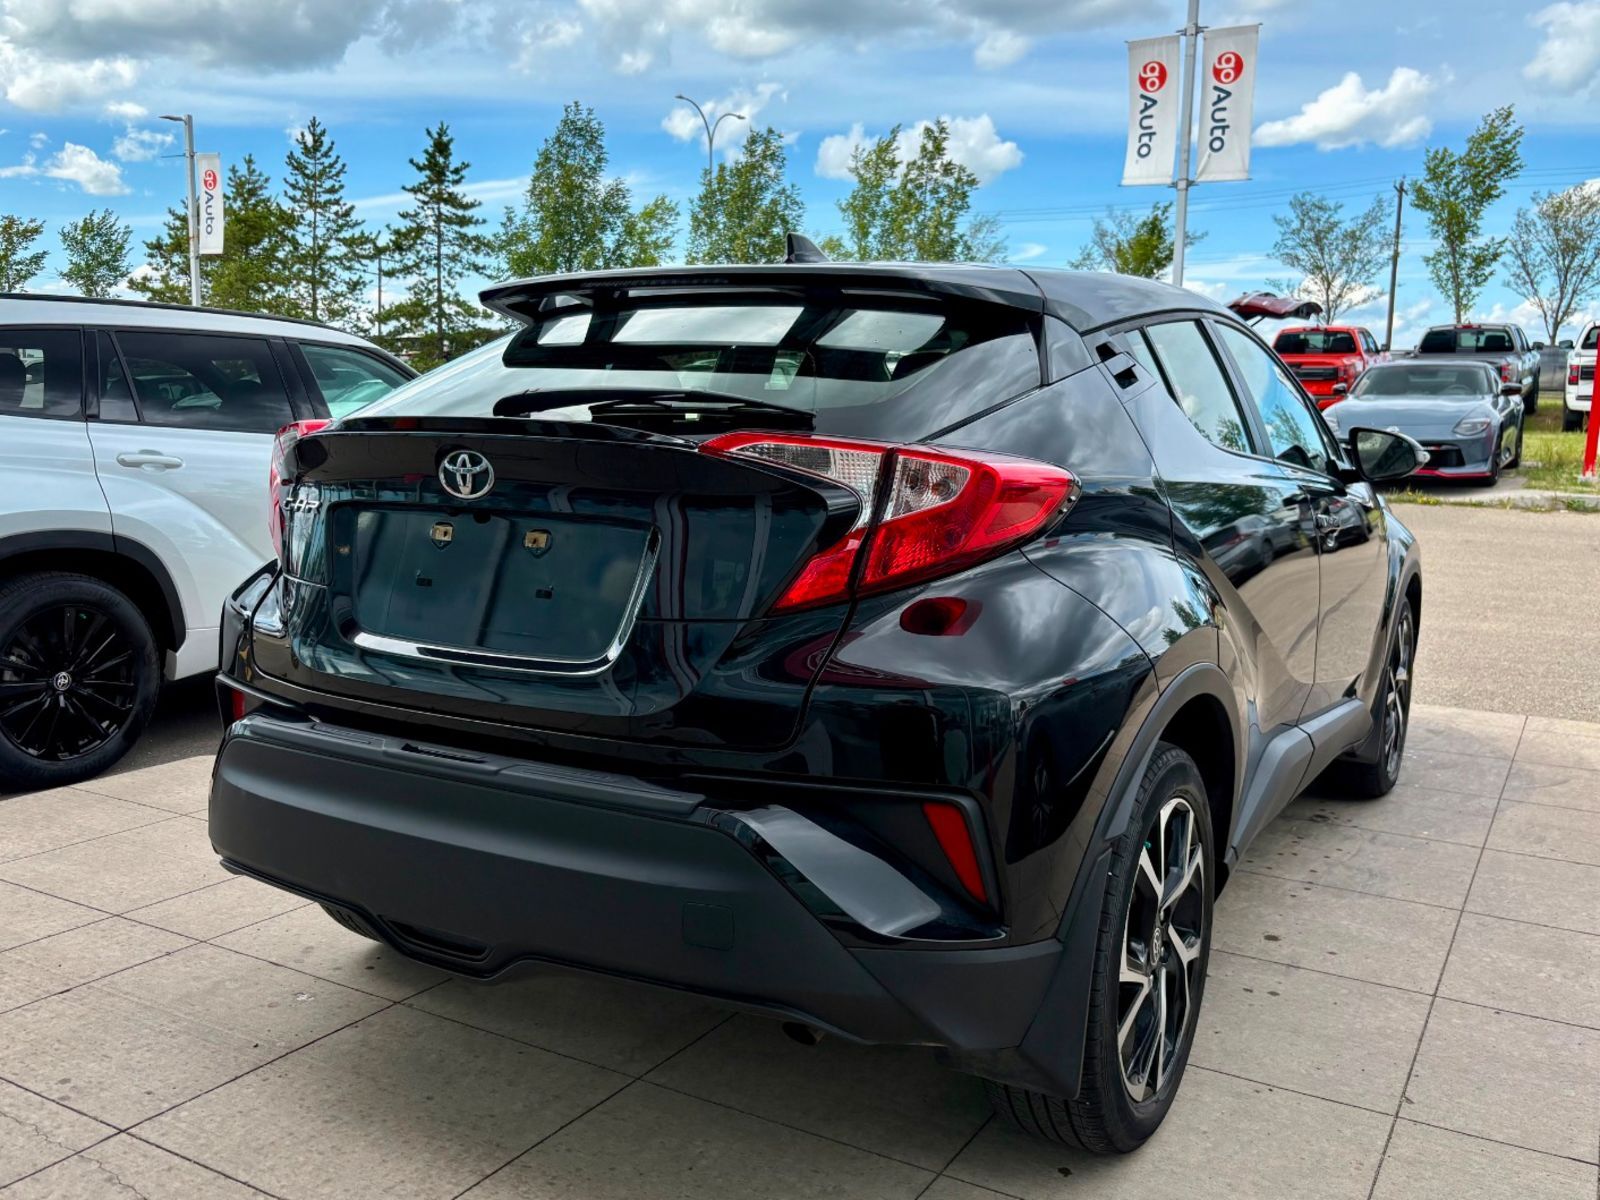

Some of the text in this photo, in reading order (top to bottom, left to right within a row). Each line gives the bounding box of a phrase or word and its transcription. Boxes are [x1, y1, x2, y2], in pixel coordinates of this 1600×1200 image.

[1136, 62, 1162, 159] go Auto
[1209, 52, 1237, 153] go Auto
[204, 170, 215, 235] go Auto
